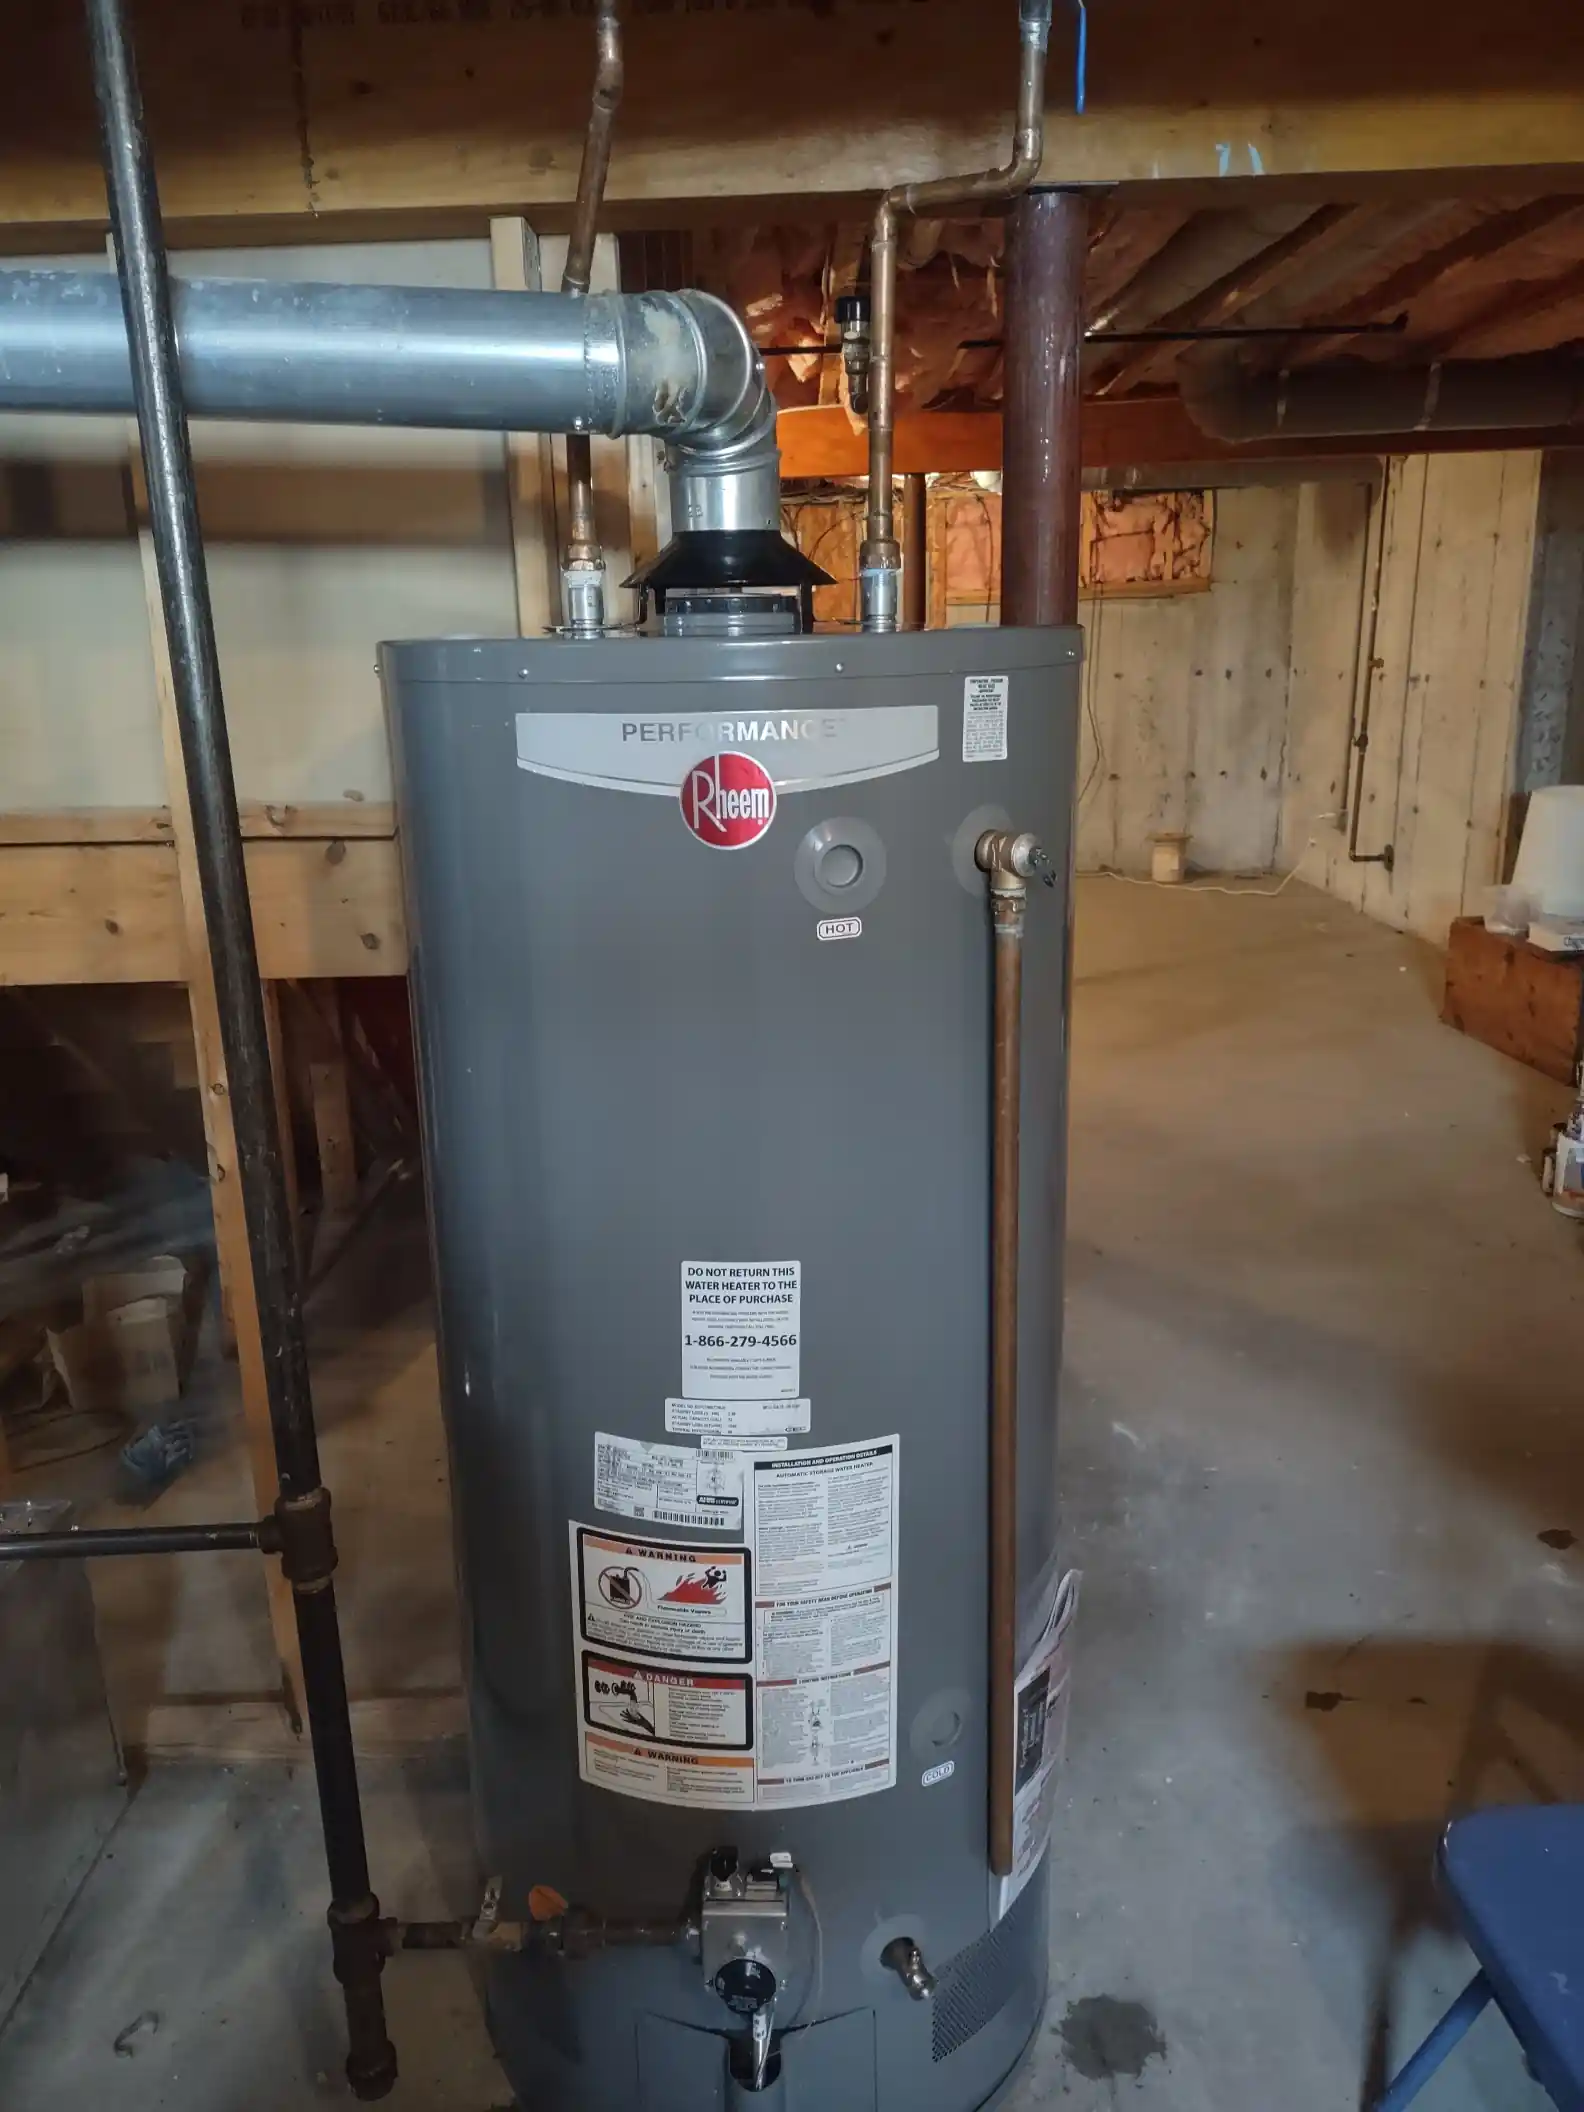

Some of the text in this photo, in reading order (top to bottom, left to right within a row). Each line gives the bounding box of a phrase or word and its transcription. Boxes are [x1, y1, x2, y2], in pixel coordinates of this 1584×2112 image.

[622, 718, 838, 742] PERFORMANCE
[691, 753, 770, 832] Rheem
[825, 922, 855, 935] HOT
[687, 1266, 796, 1277] DO NOT RETURN THIS
[684, 1280, 798, 1291] WATER HEATER TO THE
[688, 1294, 794, 1304] PLACE OF PURCHASE
[684, 1334, 798, 1348] 1-866-279-4566
[771, 1450, 878, 1469] INSTALLATION AND OPERATION DETAILS
[776, 1471, 808, 1479] AUTOMATIC
[835, 1464, 853, 1473] WATER
[854, 1461, 874, 1470] HEATER
[638, 1547, 697, 1562] WARNING
[646, 1672, 694, 1687] DANGER
[647, 1750, 699, 1764] WARNING
[924, 1766, 950, 1784] COLD
